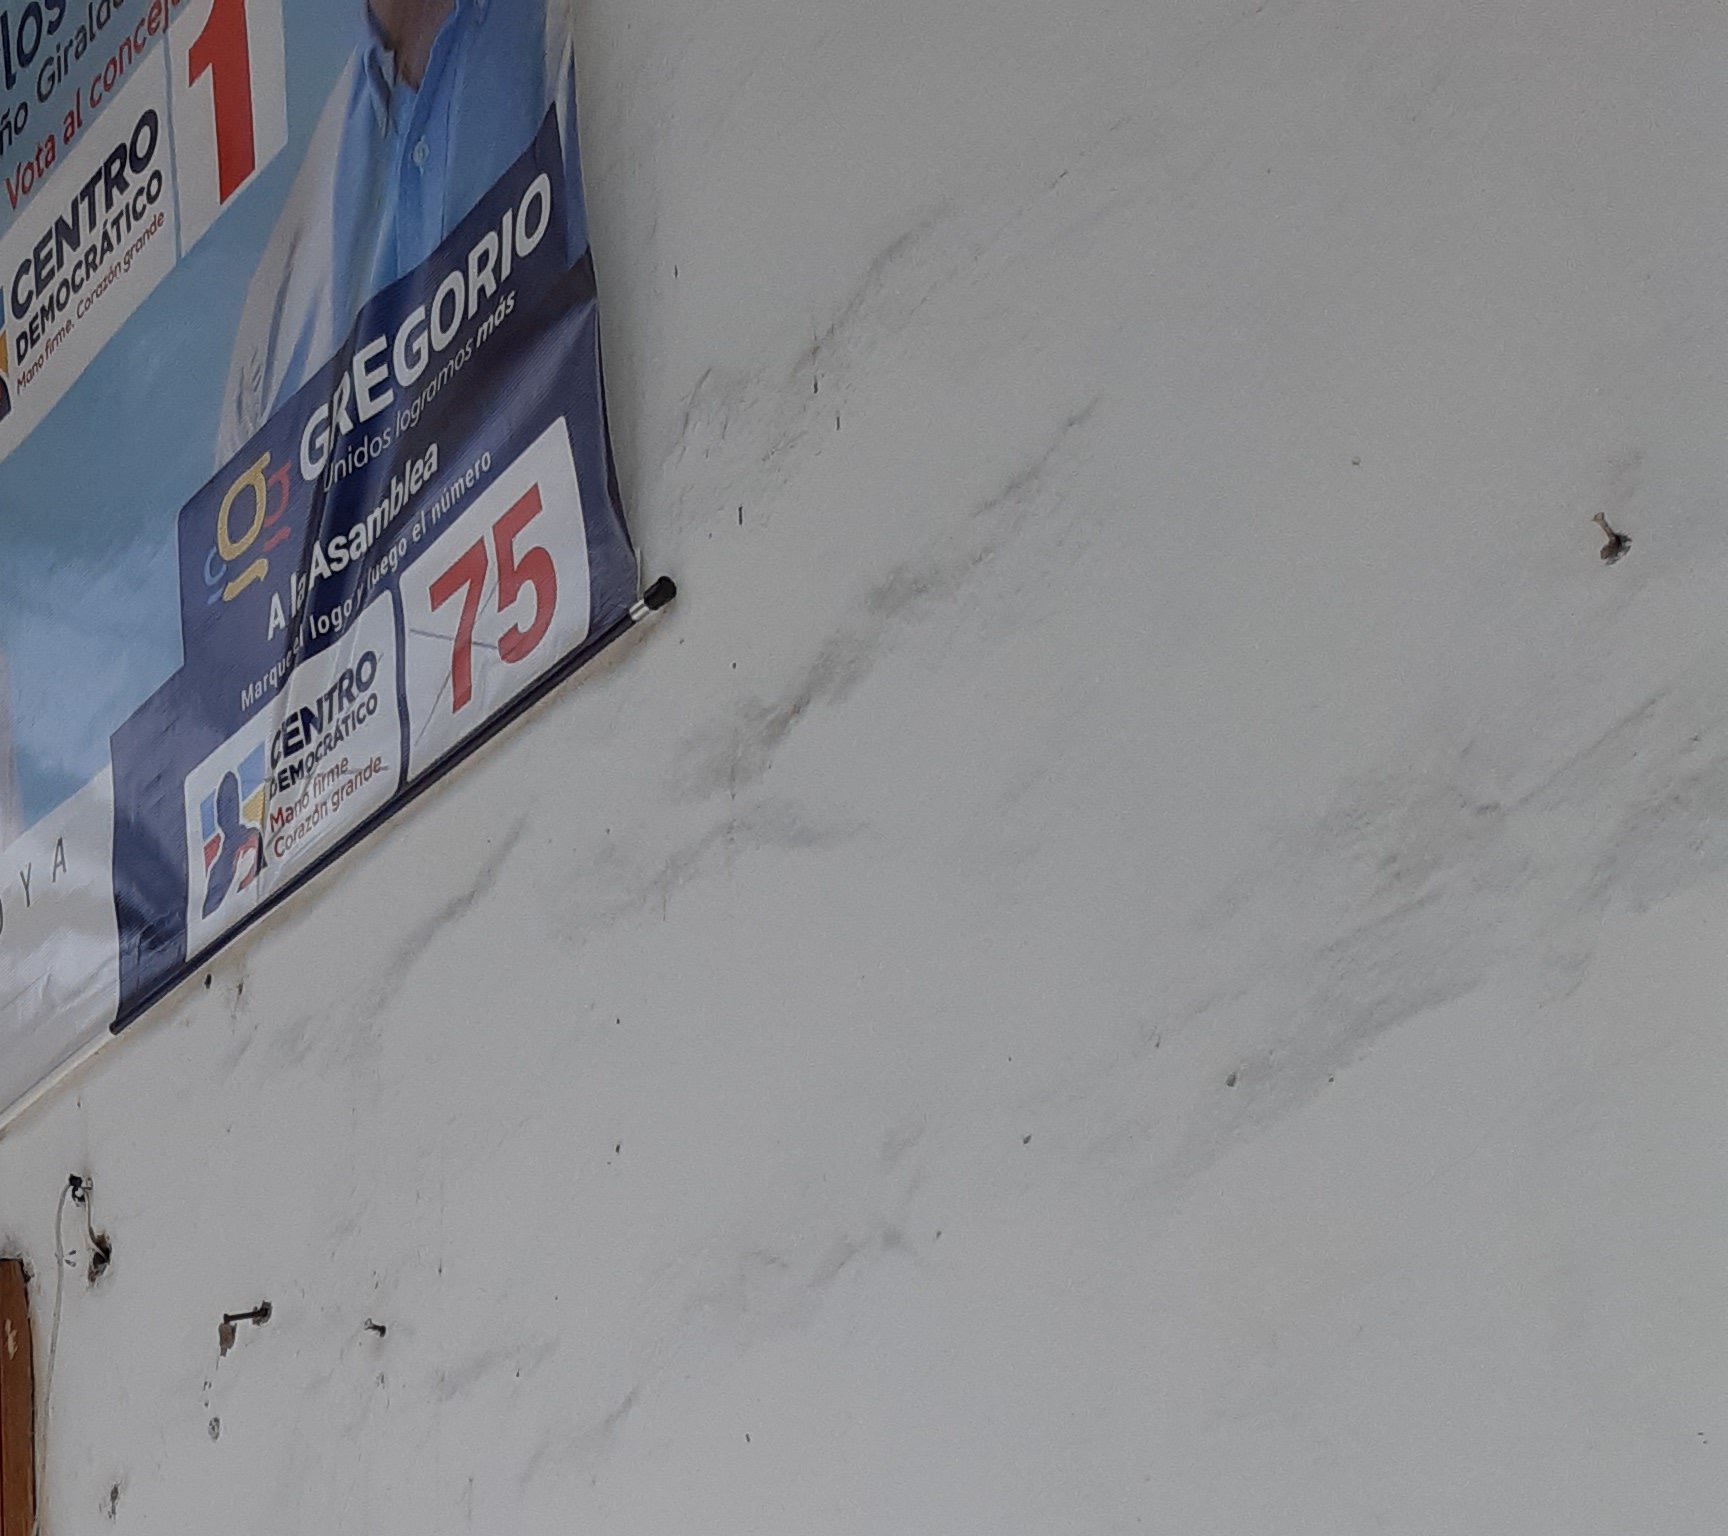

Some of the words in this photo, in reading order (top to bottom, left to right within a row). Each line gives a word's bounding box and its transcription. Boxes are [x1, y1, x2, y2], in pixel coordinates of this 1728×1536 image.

[4, 134, 56, 210] Vota
[63, 88, 83, 145] al
[88, 0, 181, 109] concej
[189, 0, 255, 205] 1
[10, 109, 159, 320] CENTRO
[15, 169, 163, 366] DEMOCRÁTICO
[16, 352, 44, 395] Mano
[76, 259, 122, 319] Corazón
[123, 211, 165, 273] grande
[299, 172, 552, 482] GREGORIO
[324, 430, 392, 494] Unidos
[394, 345, 473, 441] logramos
[476, 289, 516, 349] más
[267, 593, 285, 640] A
[291, 564, 306, 618] la
[309, 443, 439, 592] Asamblea
[309, 599, 352, 640] logo
[412, 514, 426, 542] el
[431, 451, 491, 526] número
[429, 482, 558, 715] 75
[269, 692, 378, 800] DEMOCRÁTICO
[270, 791, 310, 833] Mano
[313, 756, 350, 800] firme
[271, 650, 377, 770] CENTRO
[273, 803, 328, 858] Corazón
[331, 755, 383, 813] grande
